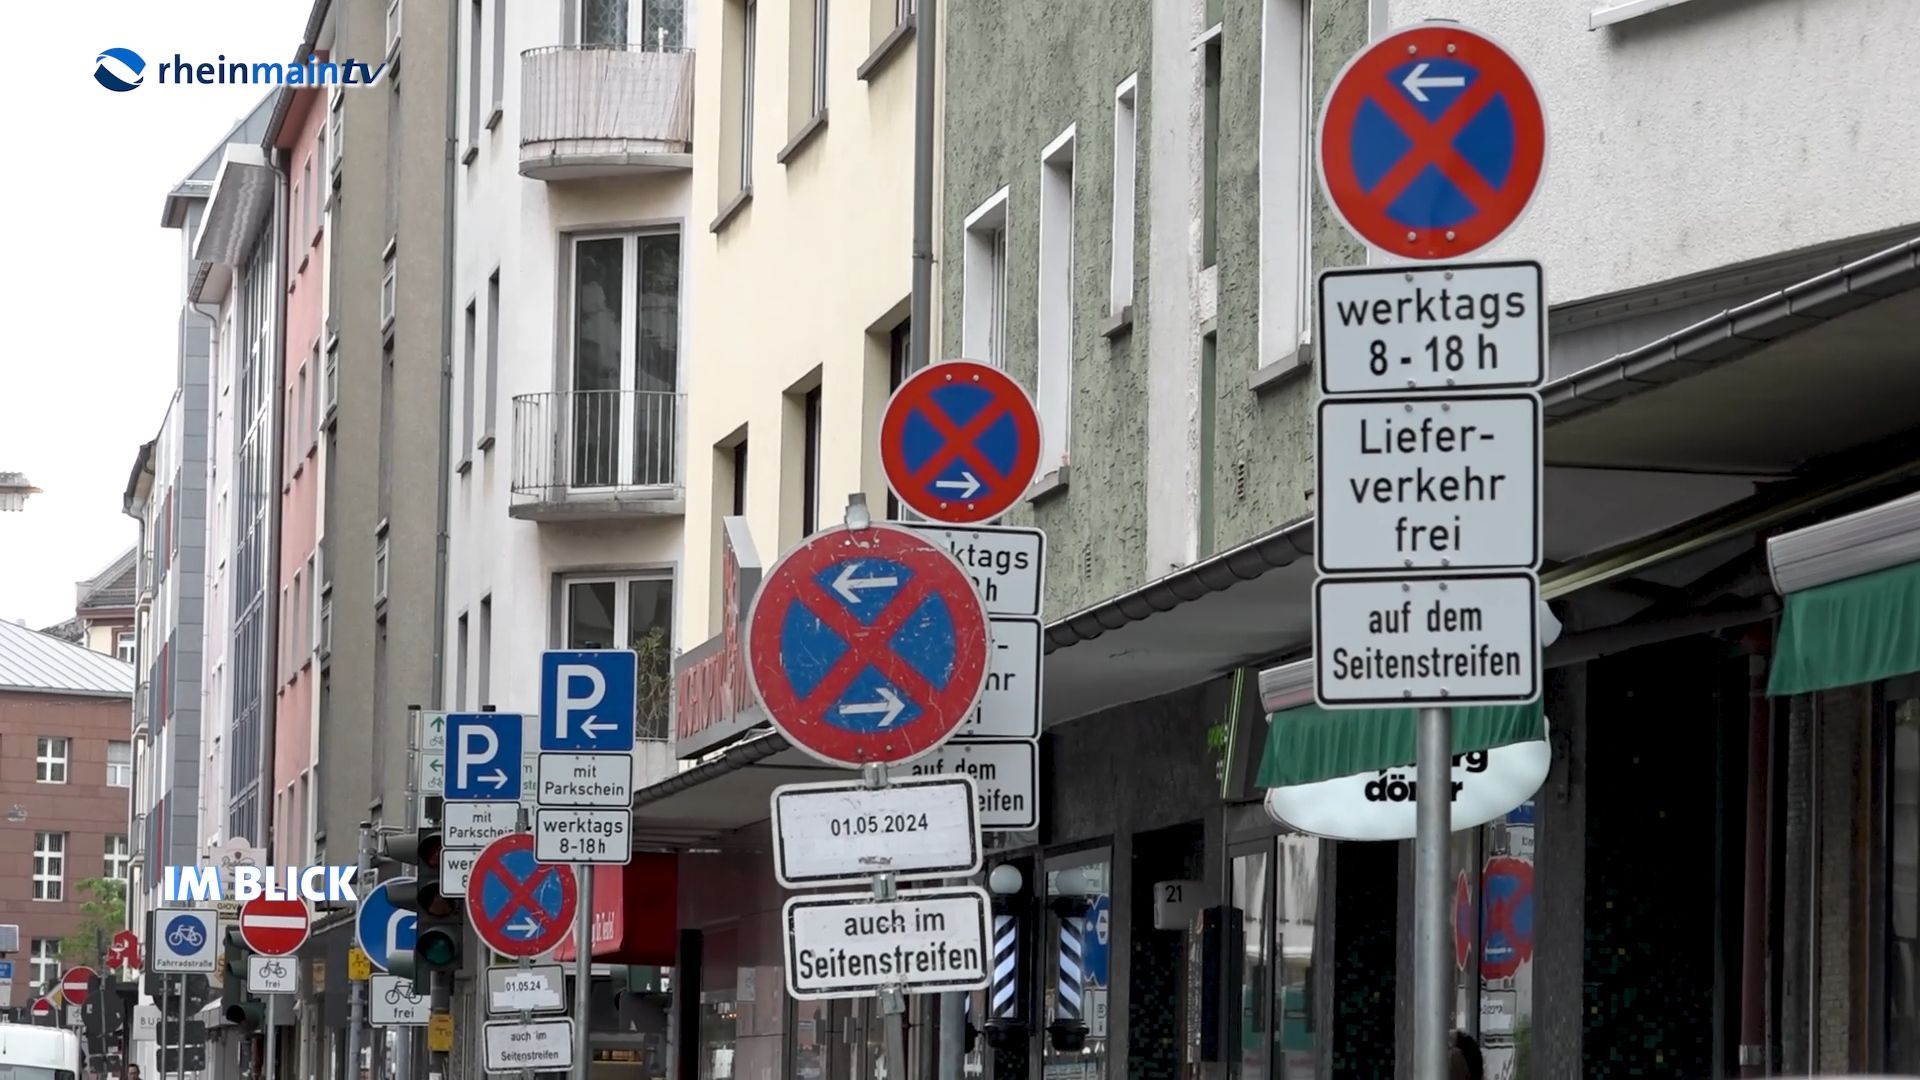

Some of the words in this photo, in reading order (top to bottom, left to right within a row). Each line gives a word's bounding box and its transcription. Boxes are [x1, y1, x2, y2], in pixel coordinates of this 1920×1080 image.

[1337, 287, 1526, 329] werktags
[1360, 417, 1495, 455] Liefer-
[1349, 466, 1506, 504] verkehr
[1395, 515, 1461, 552] frei
[950, 541, 1029, 575] ktags
[1368, 600, 1411, 634] auf
[1426, 599, 1482, 632] dem
[1332, 643, 1521, 680] Seitenstreifen
[573, 765, 597, 778] mit
[955, 757, 996, 781] dem
[544, 781, 624, 797] Parkschein
[472, 812, 492, 824] mit
[543, 818, 624, 837] werktags
[830, 813, 929, 837] 01.05.2024
[1165, 885, 1183, 902] 21
[844, 908, 906, 937] auch
[915, 908, 945, 932] im
[156, 958, 213, 968] Fahrradstraße
[799, 941, 978, 980] Seitenstreifen
[264, 978, 281, 989] frei
[505, 981, 541, 992] 01.05.24
[393, 1007, 415, 1018] frei
[510, 1031, 532, 1041] auch
[535, 1031, 547, 1040] im
[500, 1049, 559, 1062] Seitenstreifen
